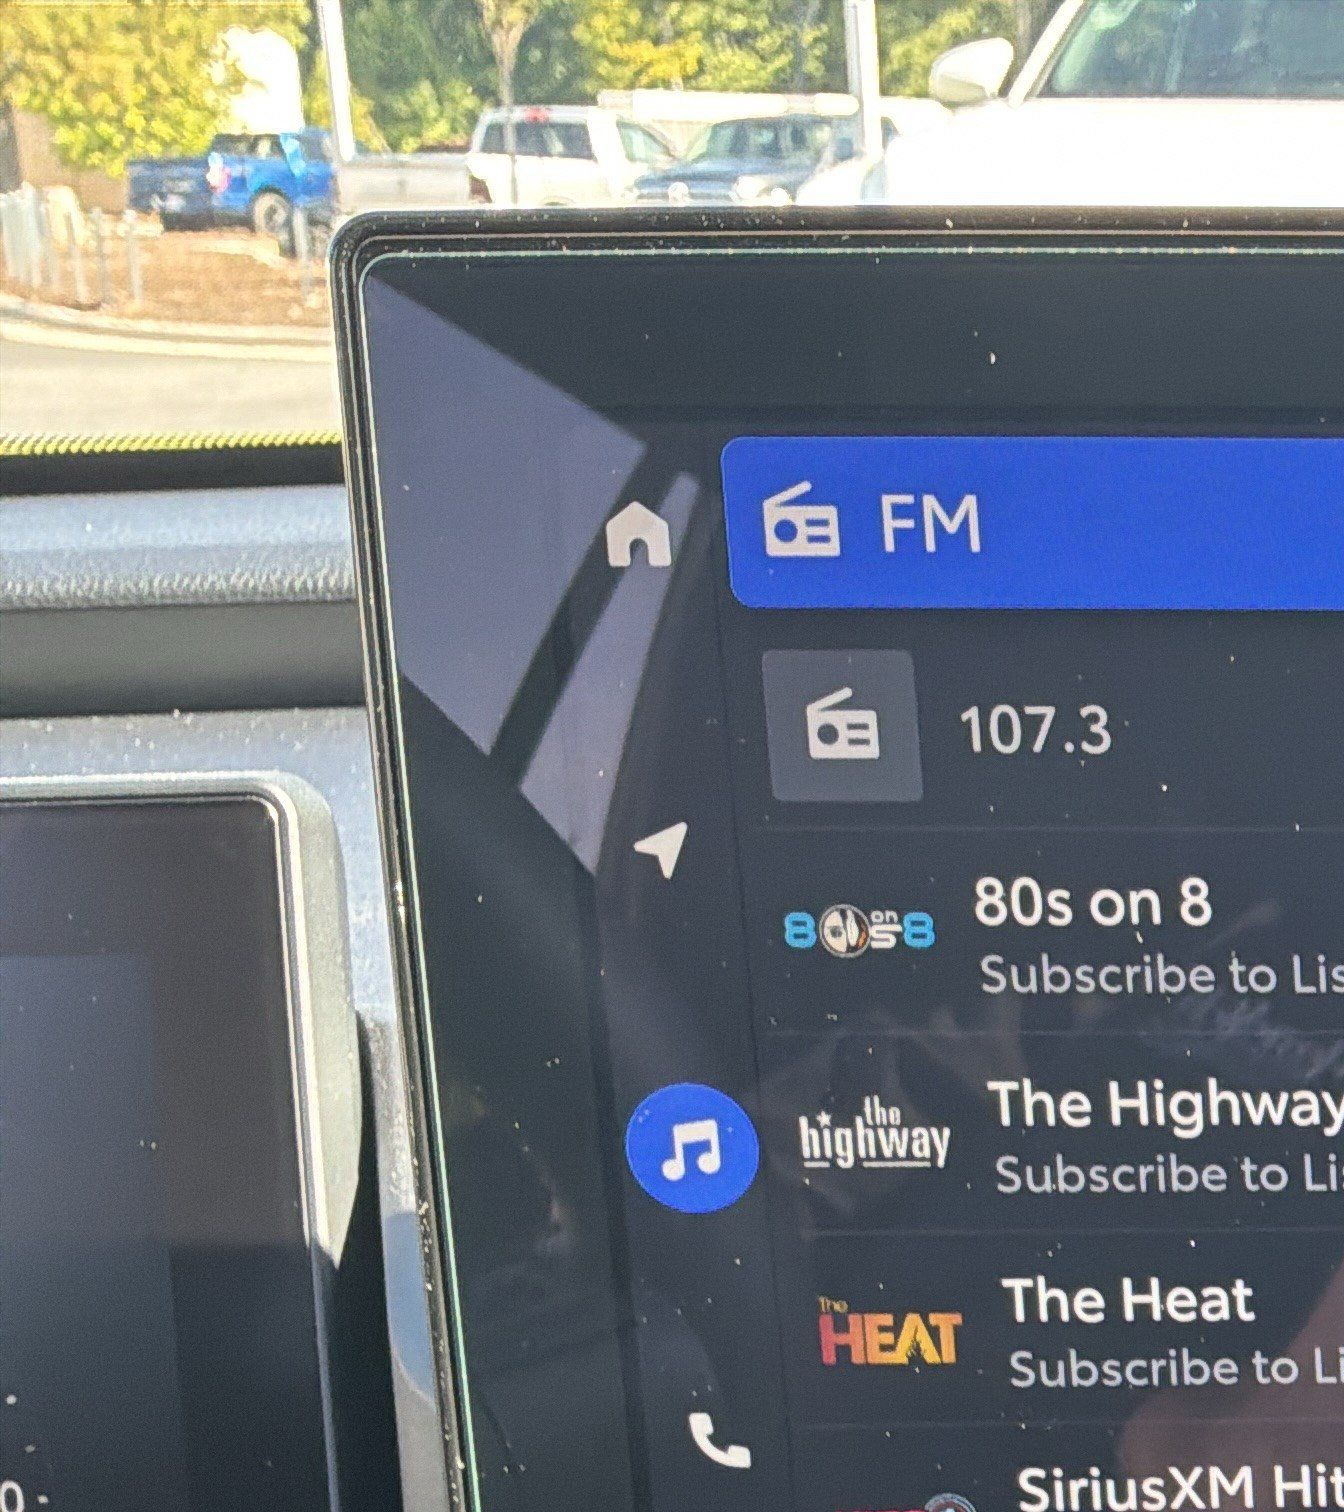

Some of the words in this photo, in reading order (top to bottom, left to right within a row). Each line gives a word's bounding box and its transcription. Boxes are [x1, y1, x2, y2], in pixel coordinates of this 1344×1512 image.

[881, 493, 983, 555] FM
[960, 704, 1112, 755] 107.3
[974, 876, 1073, 927] 80s
[1089, 888, 1162, 927] on
[1180, 876, 1213, 927] 8
[980, 952, 1216, 994] Subscribe
[1228, 957, 1277, 994] to
[986, 1077, 1092, 1128] The
[798, 1115, 951, 1169] highway
[995, 1152, 1228, 1194] Subscribe
[1240, 1156, 1289, 1192] to
[1001, 1275, 1106, 1324] The
[1122, 1276, 1256, 1323] Heat
[818, 1312, 964, 1366] HEAT
[1010, 1347, 1239, 1389] Subscribe
[1251, 1350, 1299, 1385] to
